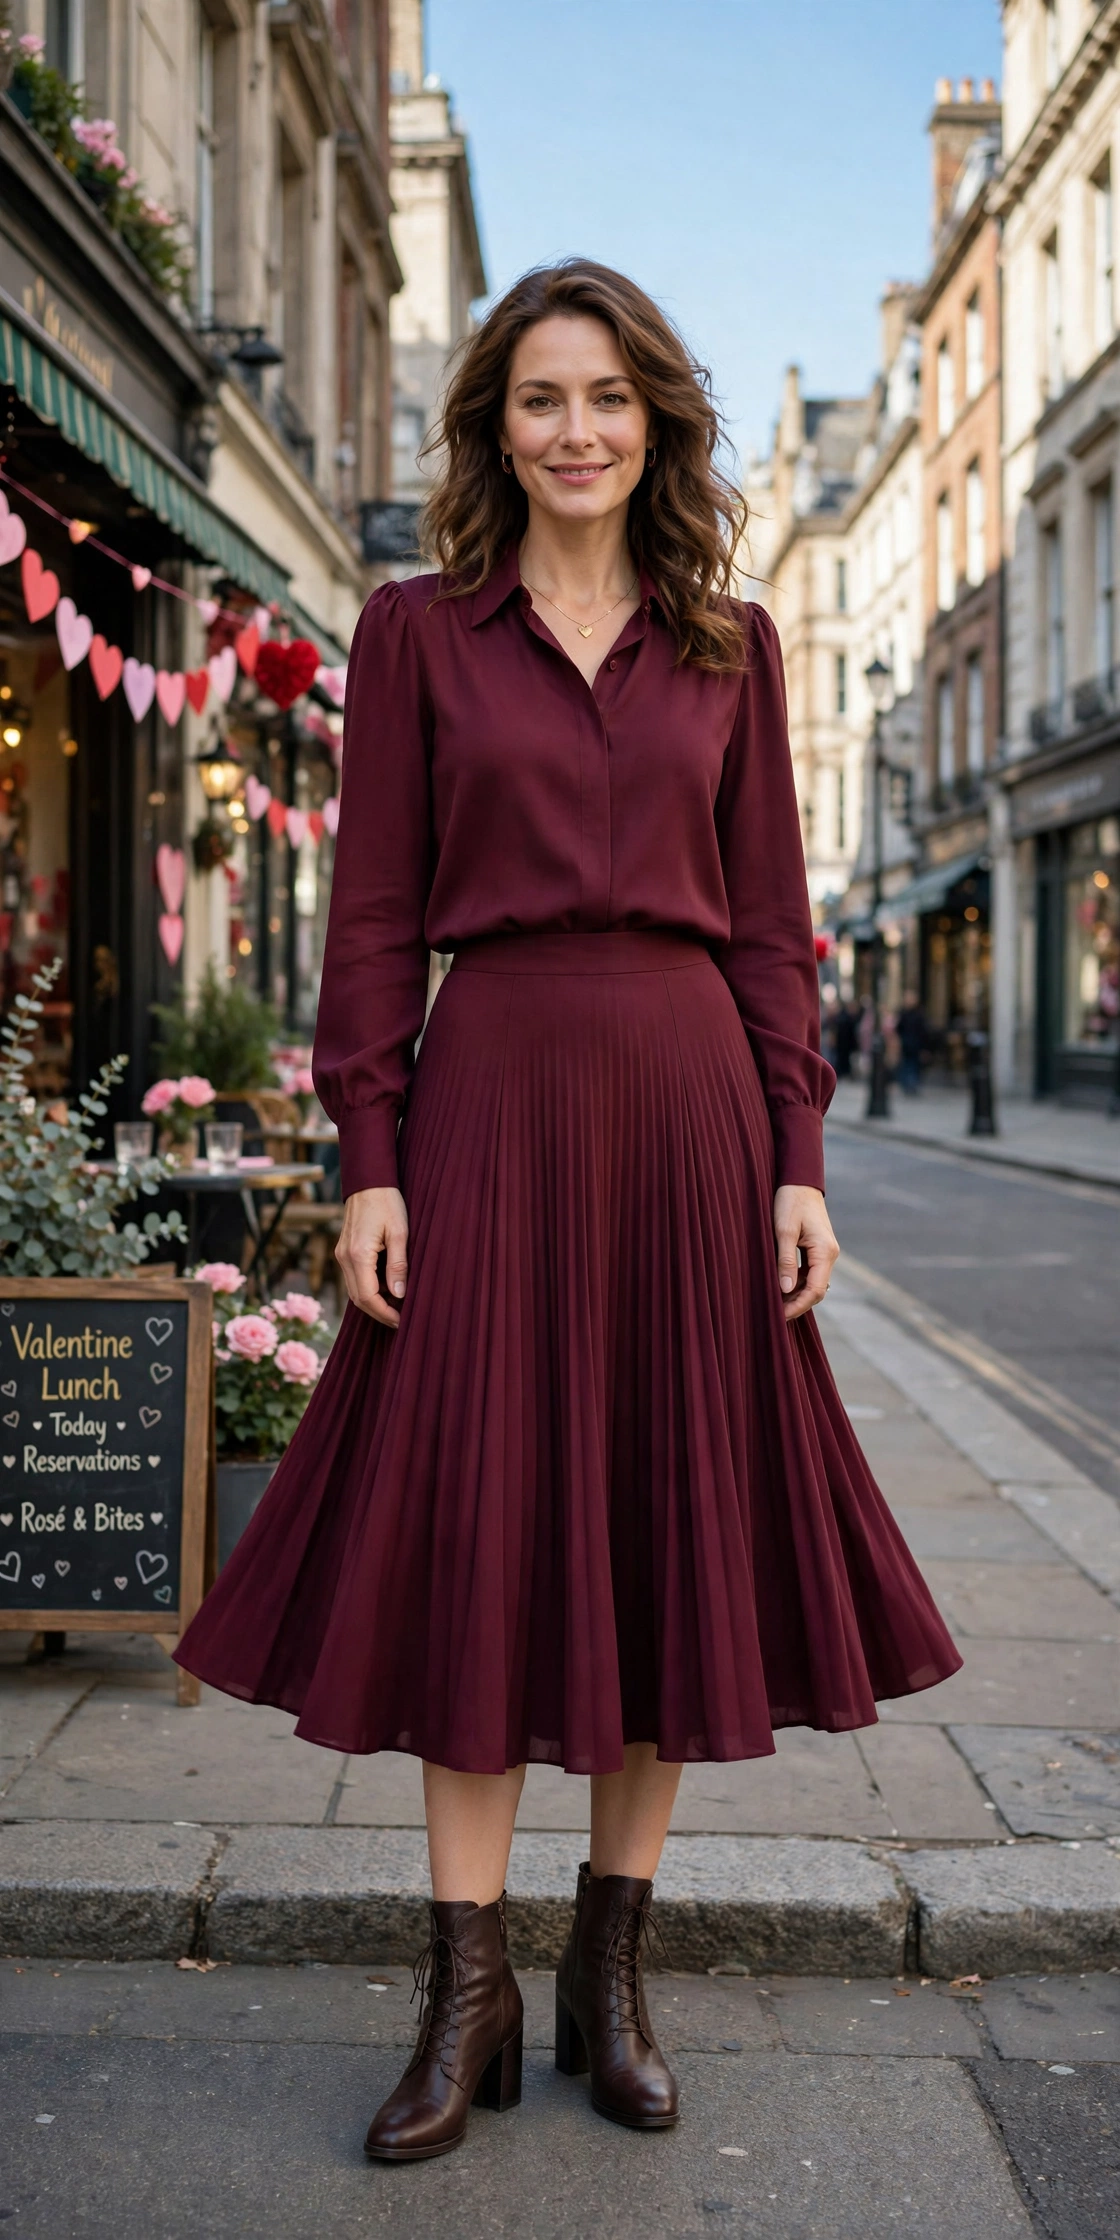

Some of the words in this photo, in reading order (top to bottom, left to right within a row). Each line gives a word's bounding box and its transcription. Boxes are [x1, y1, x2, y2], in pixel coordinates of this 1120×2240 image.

[10, 1322, 133, 1360] Valentine
[41, 1366, 121, 1401] Lunch
[49, 1411, 107, 1445] Today
[23, 1444, 141, 1473] Reservations
[21, 1501, 66, 1533] Rosé
[73, 1506, 87, 1531] &
[94, 1502, 145, 1532] Bites
